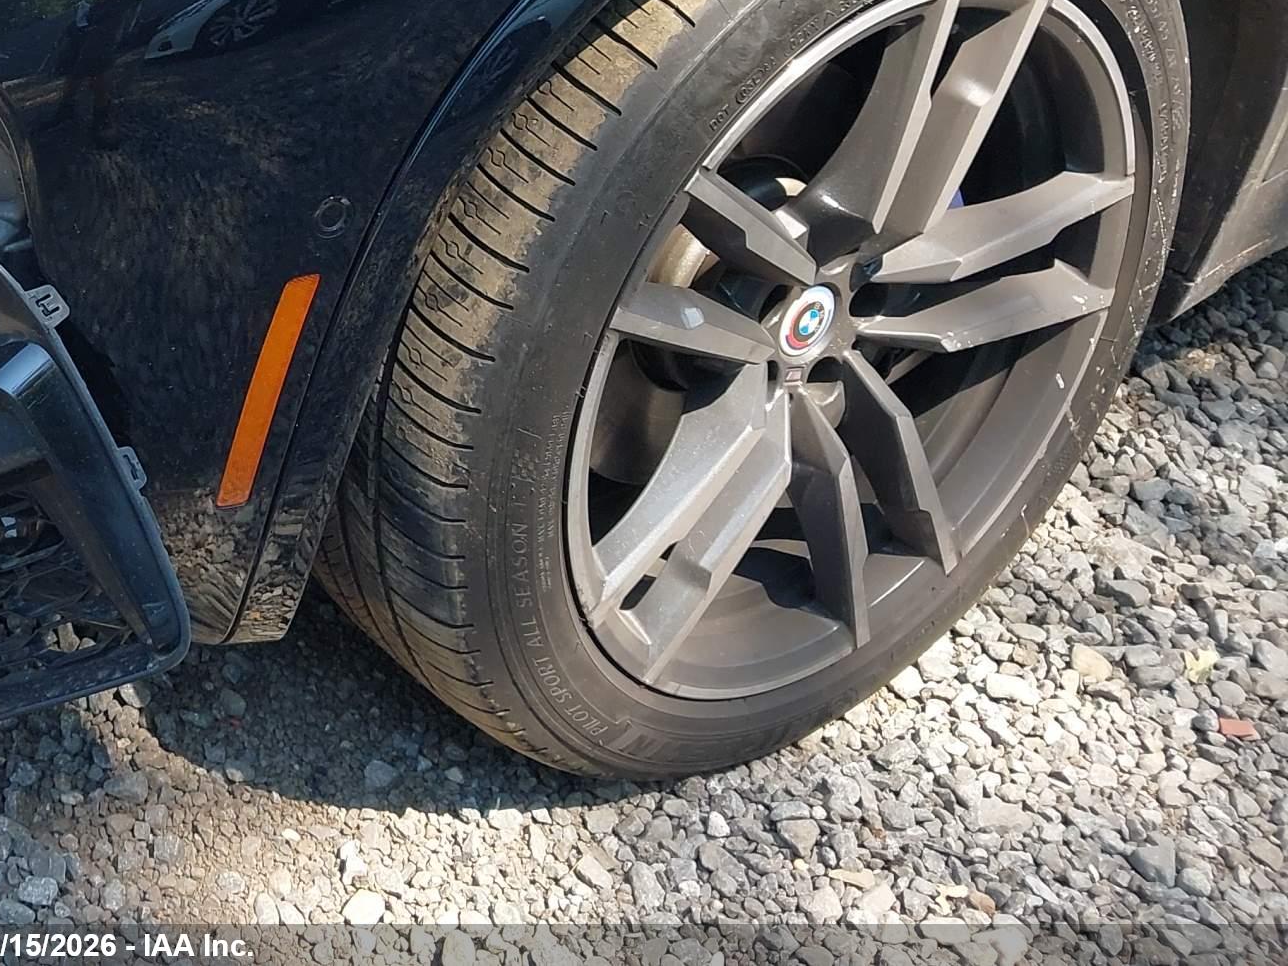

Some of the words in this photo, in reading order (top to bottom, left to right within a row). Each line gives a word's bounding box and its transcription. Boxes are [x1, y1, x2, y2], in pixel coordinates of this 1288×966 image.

[512, 522, 533, 608] SEASON
[520, 617, 545, 648] ALL
[534, 657, 573, 704] SPORT
[564, 702, 609, 737] PILOT
